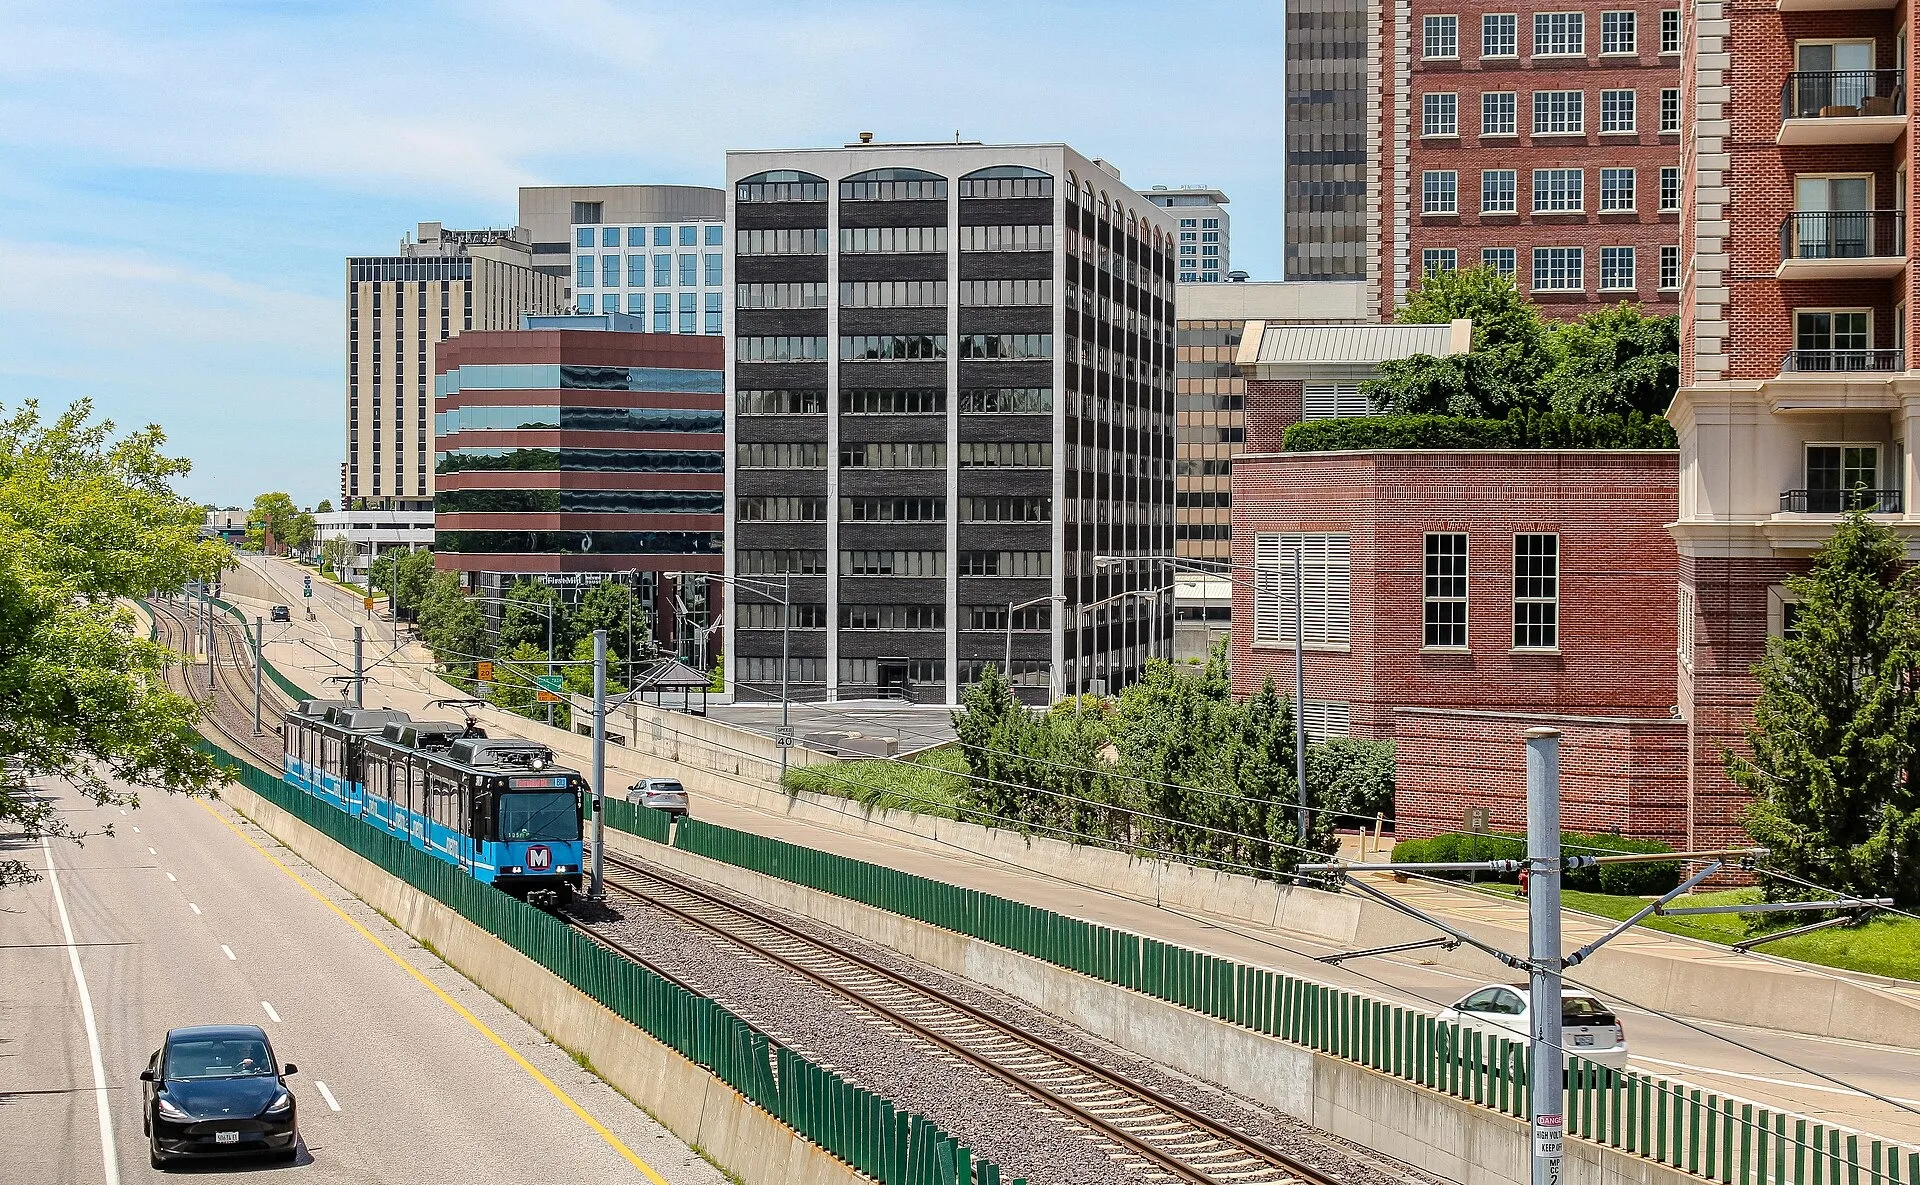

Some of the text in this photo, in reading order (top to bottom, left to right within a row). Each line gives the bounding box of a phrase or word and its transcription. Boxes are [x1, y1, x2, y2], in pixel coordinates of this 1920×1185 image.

[777, 737, 792, 746] 40
[530, 849, 548, 867] M
[1536, 1130, 1549, 1140] HIGH
[1541, 1143, 1556, 1152] KEEP
[1550, 1159, 1560, 1167] MP
[1550, 1166, 1560, 1174] CC
[1550, 1174, 1558, 1185] 2
